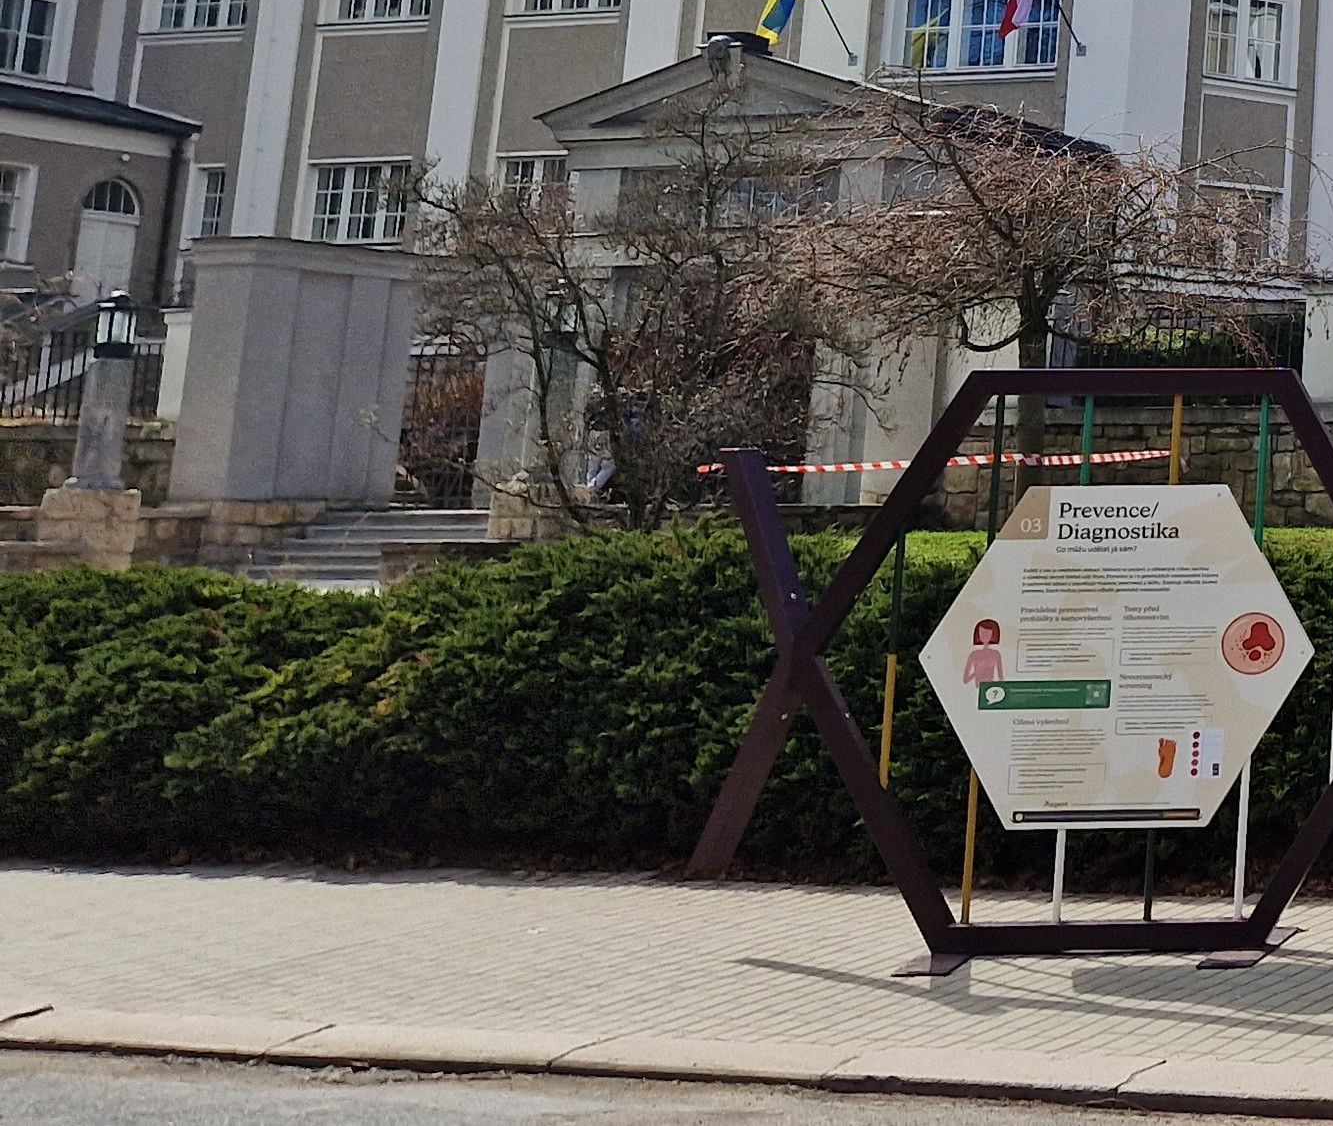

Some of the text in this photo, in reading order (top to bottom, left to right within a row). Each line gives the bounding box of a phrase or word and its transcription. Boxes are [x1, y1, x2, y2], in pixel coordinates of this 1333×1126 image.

[1059, 501, 1160, 519] Prevence/
[1020, 517, 1042, 533] 03
[1057, 522, 1180, 543] Diagnostika
